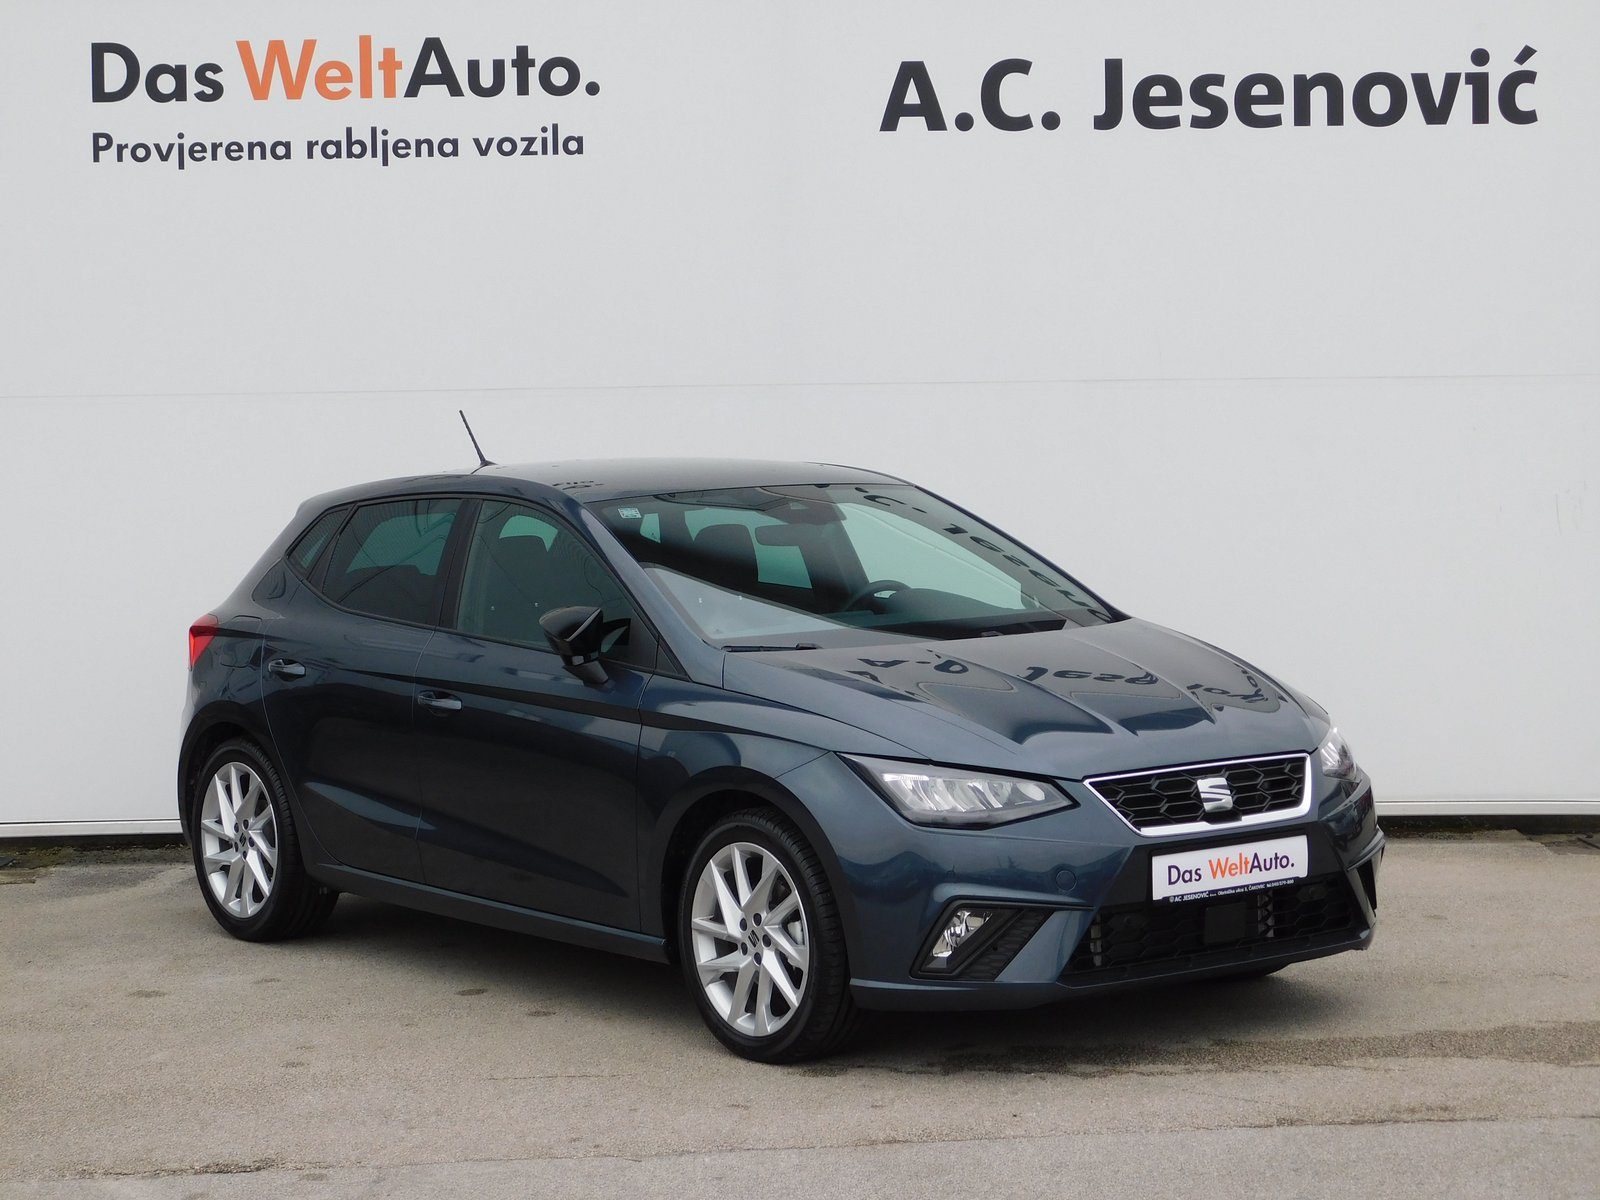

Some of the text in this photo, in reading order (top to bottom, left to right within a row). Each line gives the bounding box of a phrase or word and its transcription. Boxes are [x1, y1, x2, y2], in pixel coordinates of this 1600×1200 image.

[91, 35, 601, 103] Das WeltAuto.
[879, 44, 1538, 132] A.C. Jesenović
[92, 123, 584, 170] Provjerena rabljena vozila
[1168, 852, 1295, 886] Das WeltAuto.
